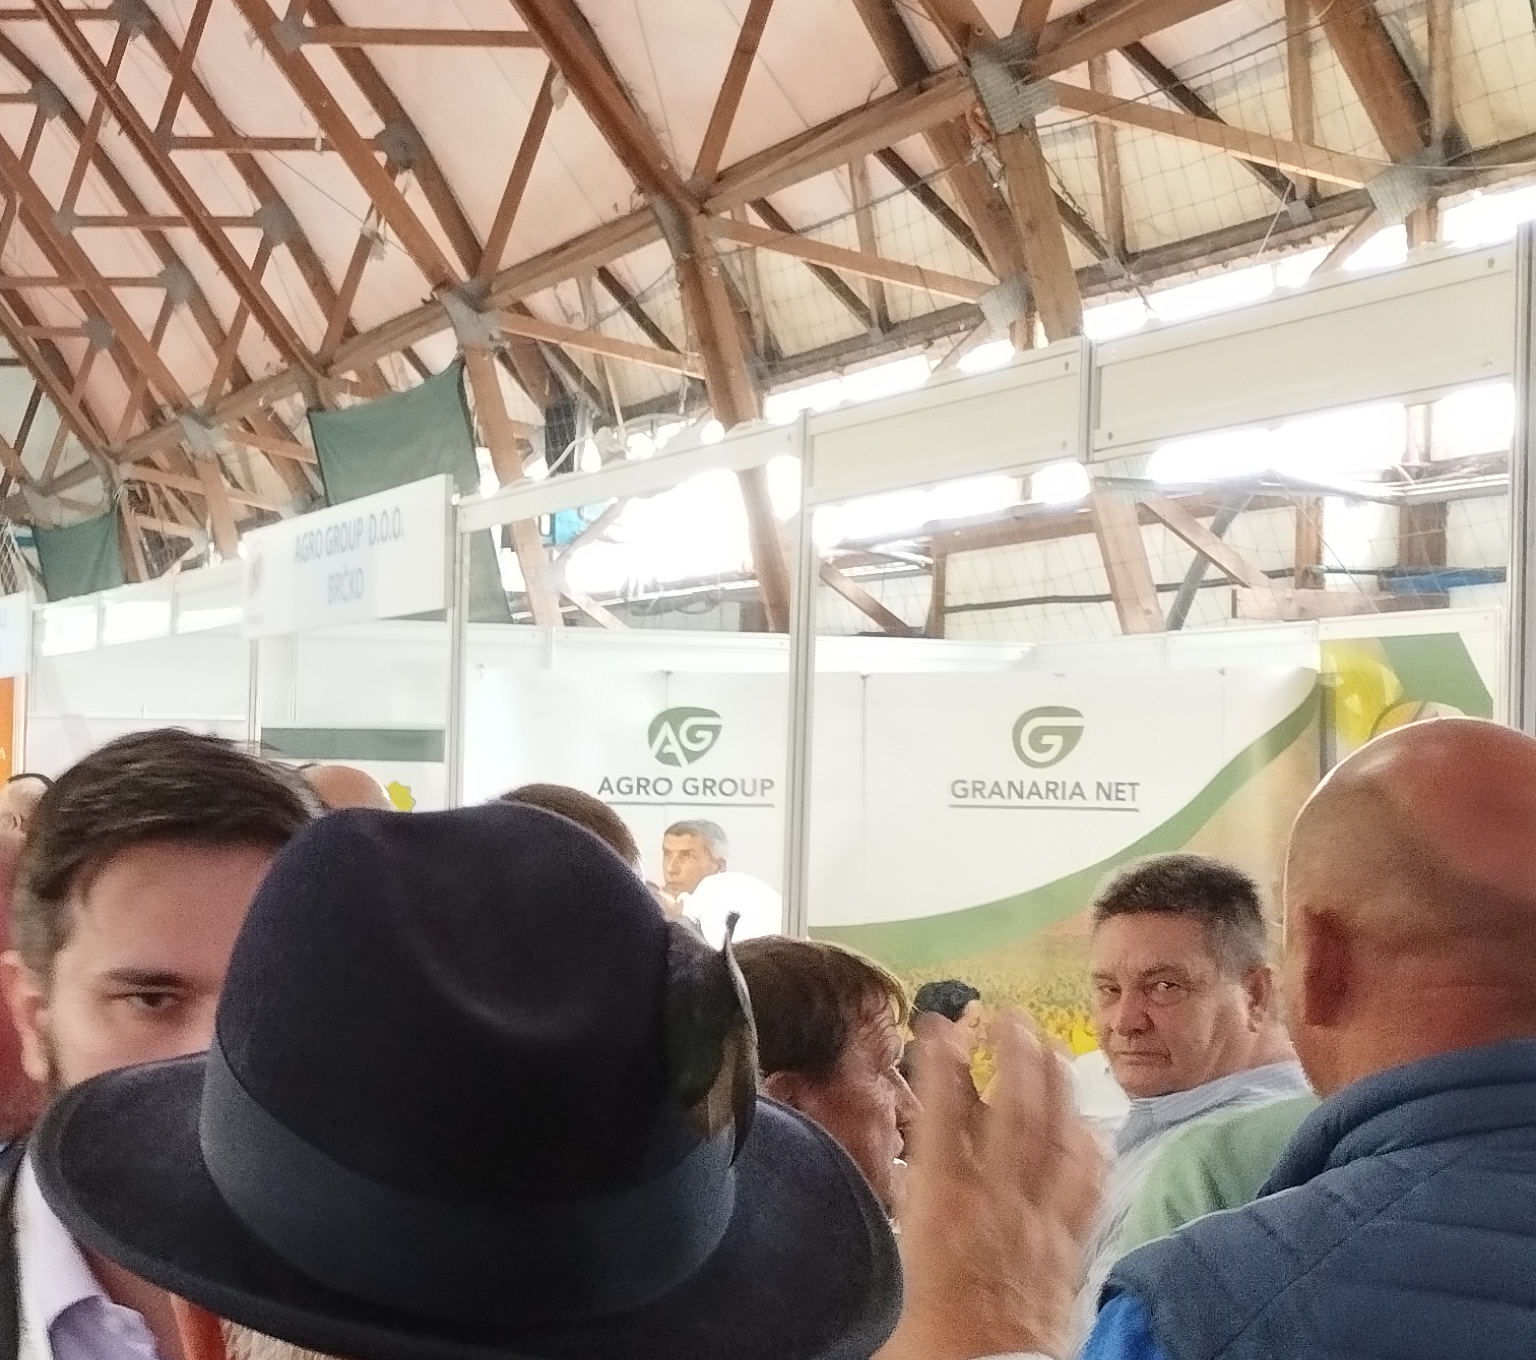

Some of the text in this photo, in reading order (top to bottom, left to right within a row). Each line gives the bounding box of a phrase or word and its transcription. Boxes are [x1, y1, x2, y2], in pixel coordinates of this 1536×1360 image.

[295, 529, 322, 562] AGRO
[325, 517, 364, 557] GROUP
[597, 775, 775, 798] AGRO GROUP
[950, 778, 1140, 803] GRANARIA NET
